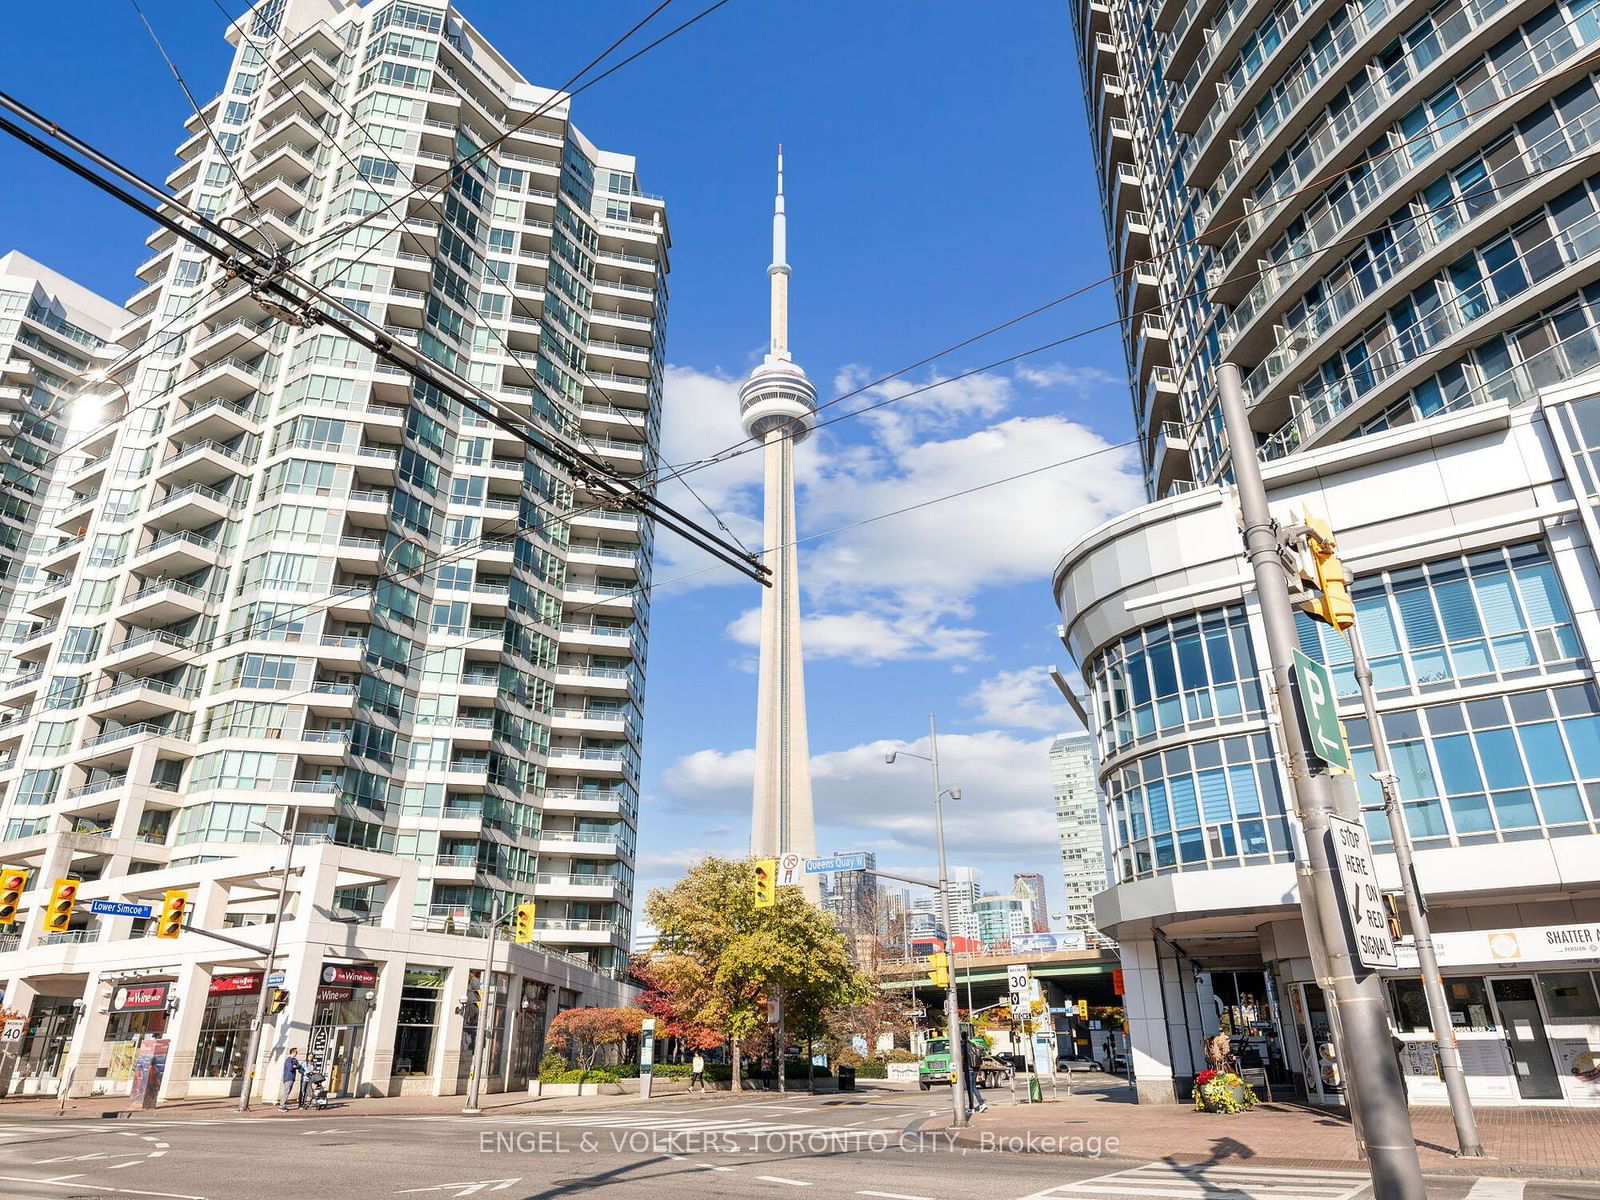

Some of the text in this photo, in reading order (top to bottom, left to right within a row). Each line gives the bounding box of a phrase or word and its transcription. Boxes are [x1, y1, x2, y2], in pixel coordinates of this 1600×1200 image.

[1303, 666, 1325, 720] P
[1340, 826, 1360, 849] STOP
[806, 859, 834, 871] Queens
[835, 857, 855, 868] Quay
[1345, 854, 1369, 876] HERE
[1365, 883, 1379, 903] ON
[93, 901, 116, 912] Lower
[116, 903, 142, 914] Simcoe
[1366, 909, 1385, 929] RED
[1545, 929, 1593, 945] SHATTER
[1360, 934, 1392, 960] SIGNAL
[345, 971, 363, 982] Wine
[1011, 975, 1027, 988] 30
[134, 991, 151, 1004] Wine
[321, 989, 339, 1001] Wine
[4, 1028, 21, 1040] 40
